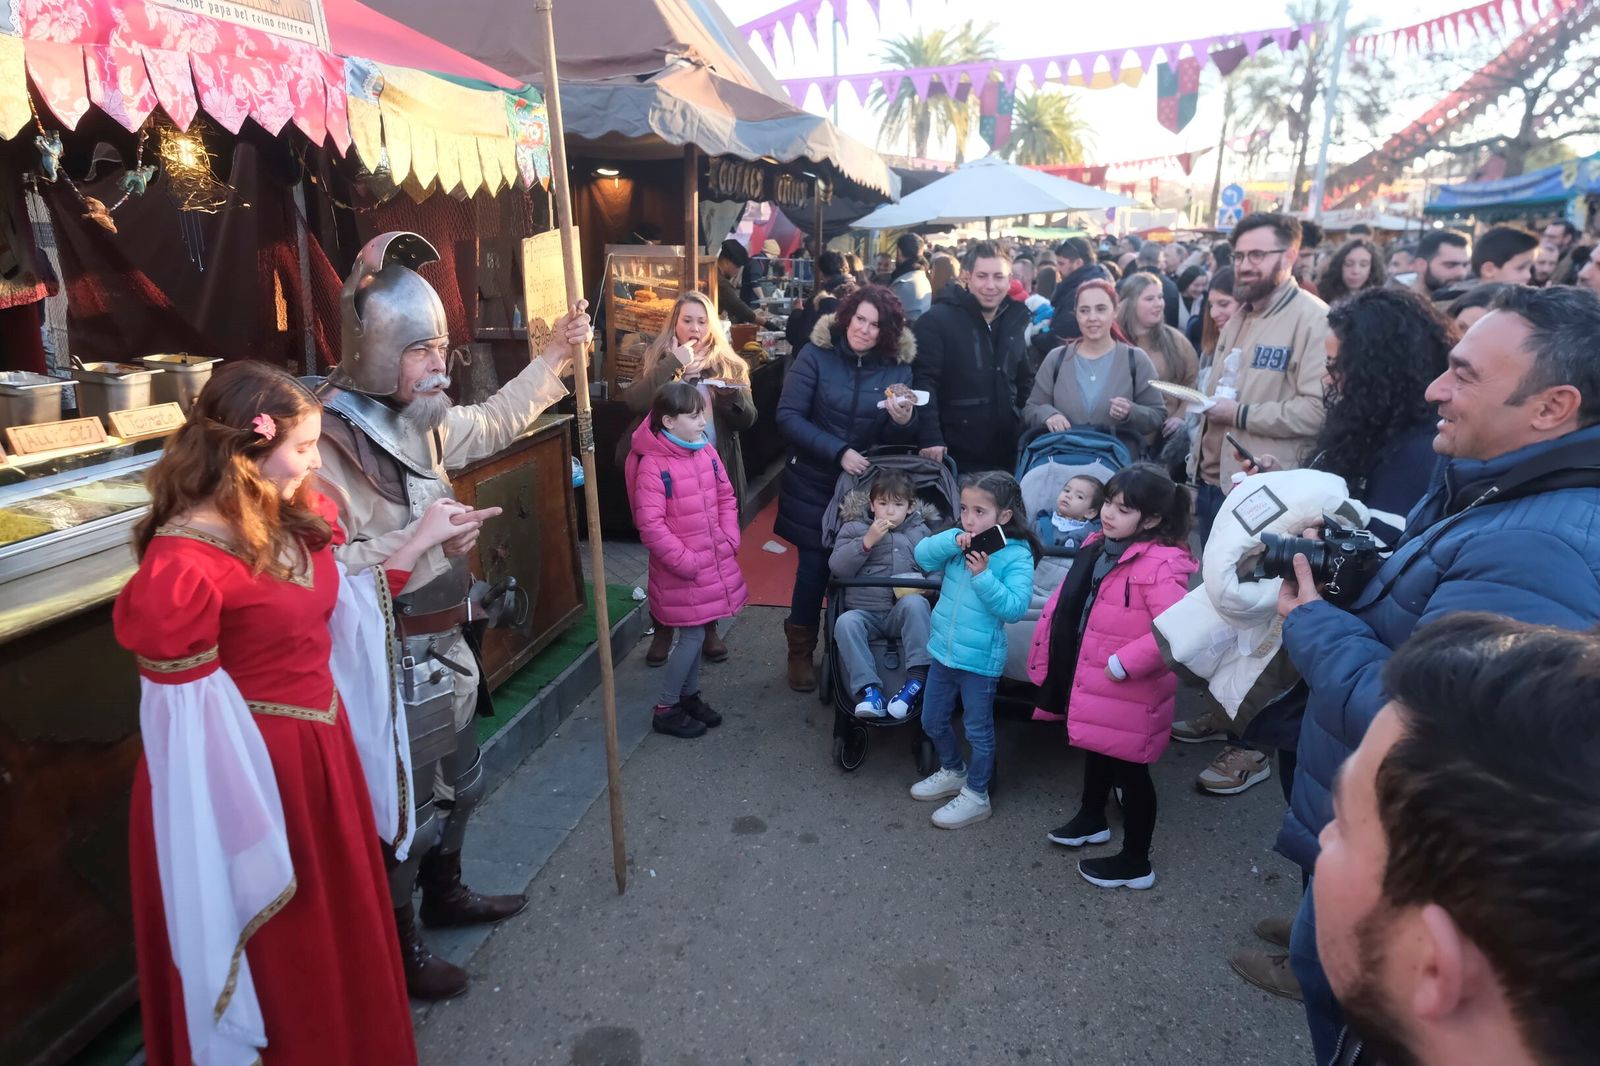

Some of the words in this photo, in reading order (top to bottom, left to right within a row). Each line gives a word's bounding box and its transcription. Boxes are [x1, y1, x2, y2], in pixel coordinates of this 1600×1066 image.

[208, 3, 231, 17] papa
[235, 7, 249, 21] del
[252, 13, 275, 27] reino
[277, 21, 303, 35] entero
